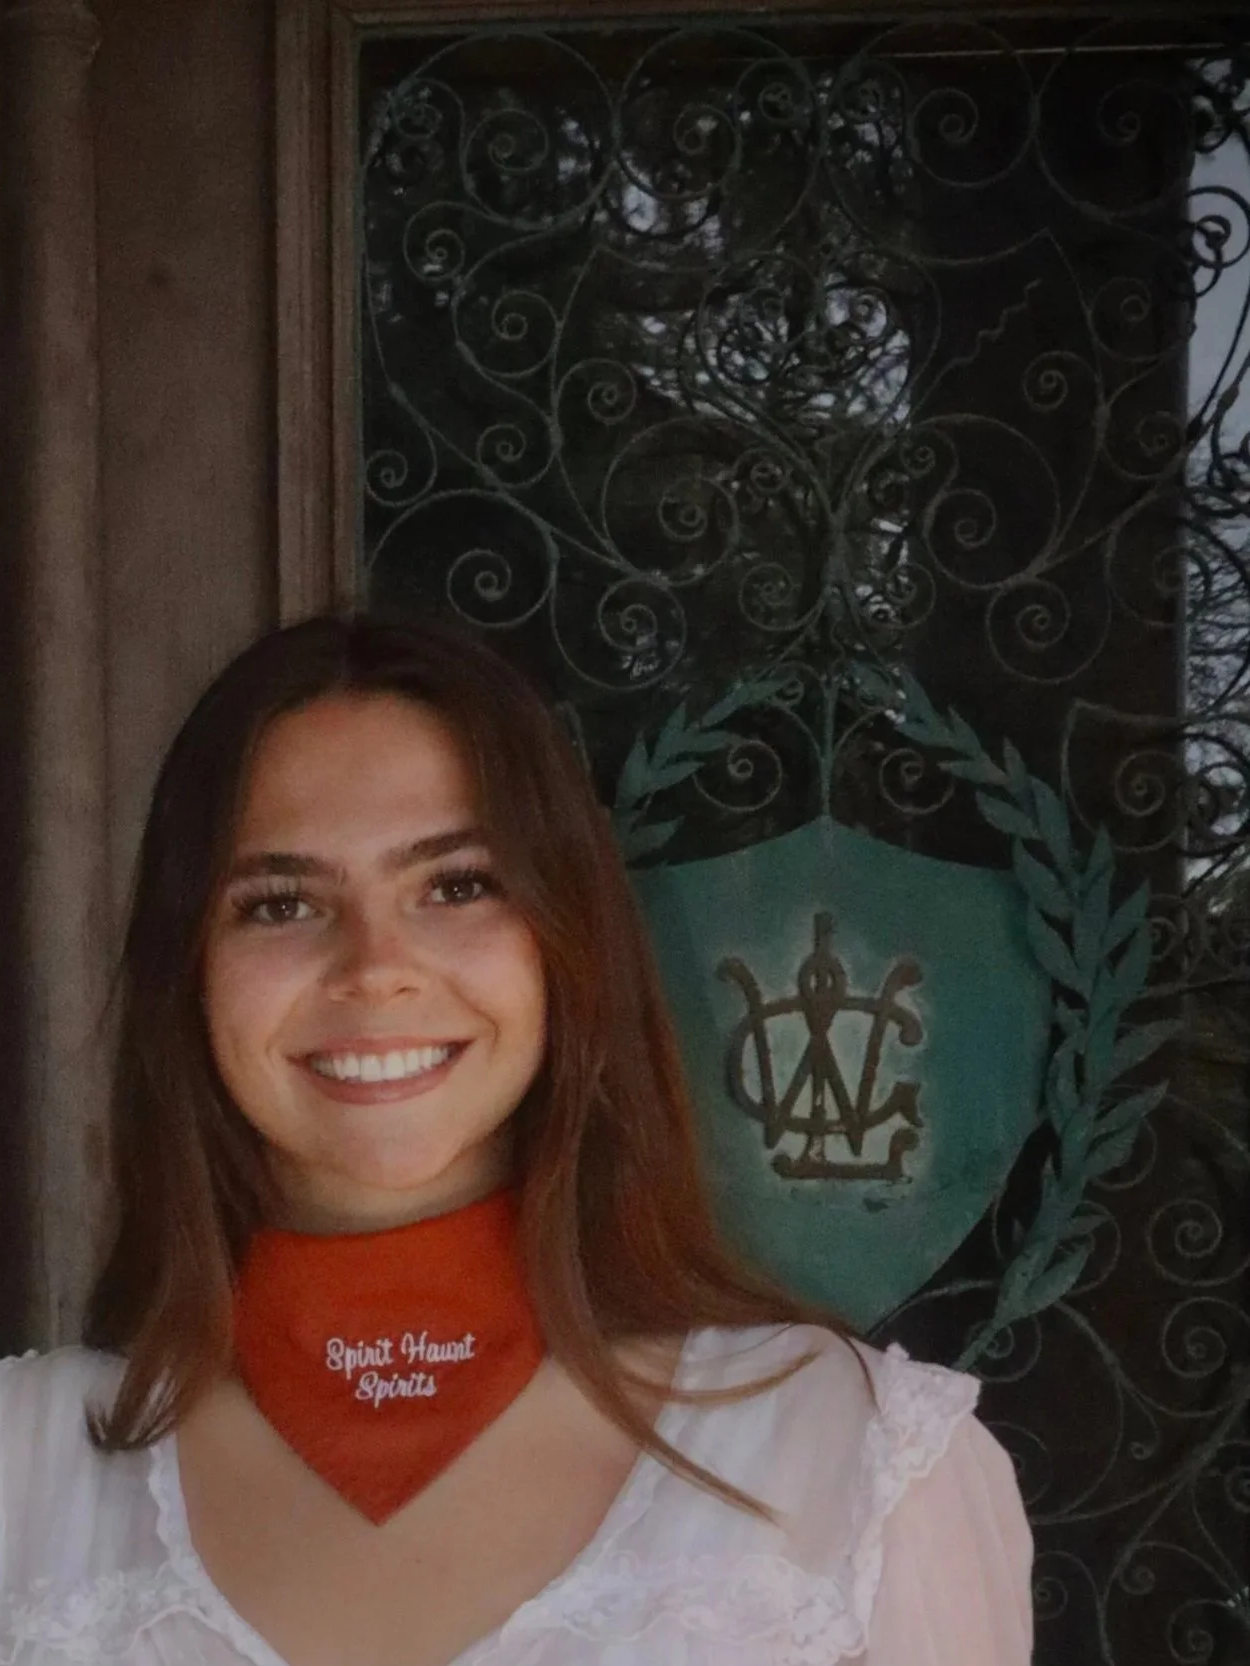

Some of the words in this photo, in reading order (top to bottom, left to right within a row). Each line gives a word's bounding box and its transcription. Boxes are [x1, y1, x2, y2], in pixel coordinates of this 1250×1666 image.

[326, 1337, 393, 1380] Spirit
[400, 1331, 476, 1364] Haunt
[355, 1371, 437, 1408] Spirits
